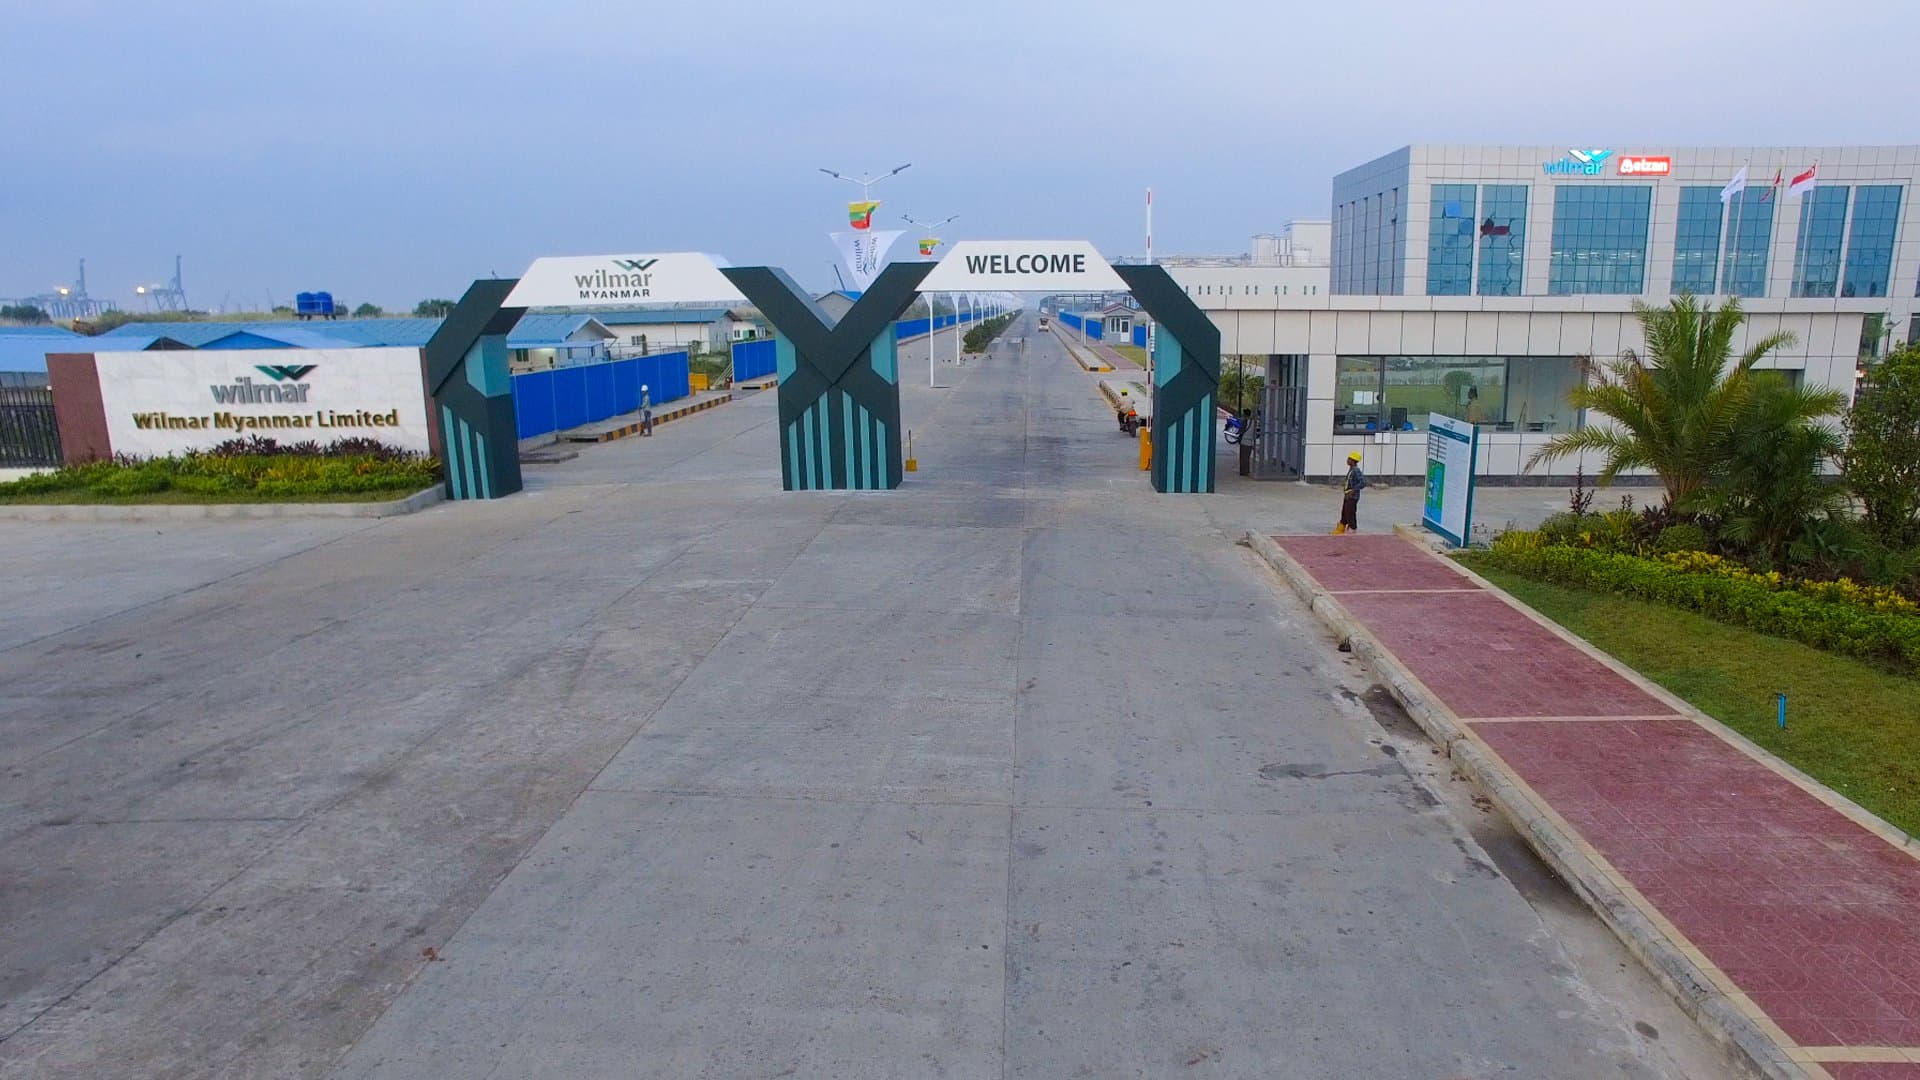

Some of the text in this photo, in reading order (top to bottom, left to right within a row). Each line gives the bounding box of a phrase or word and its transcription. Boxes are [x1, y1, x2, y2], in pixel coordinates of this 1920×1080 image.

[1543, 158, 1602, 175] wilmar
[854, 239, 863, 273] wilmar
[966, 254, 1086, 274] WELCOME
[574, 269, 653, 289] wilmar
[579, 289, 650, 299] MYANMAR
[210, 376, 310, 404] wilmar
[132, 409, 400, 432] Wilmar Myanmar Limited
